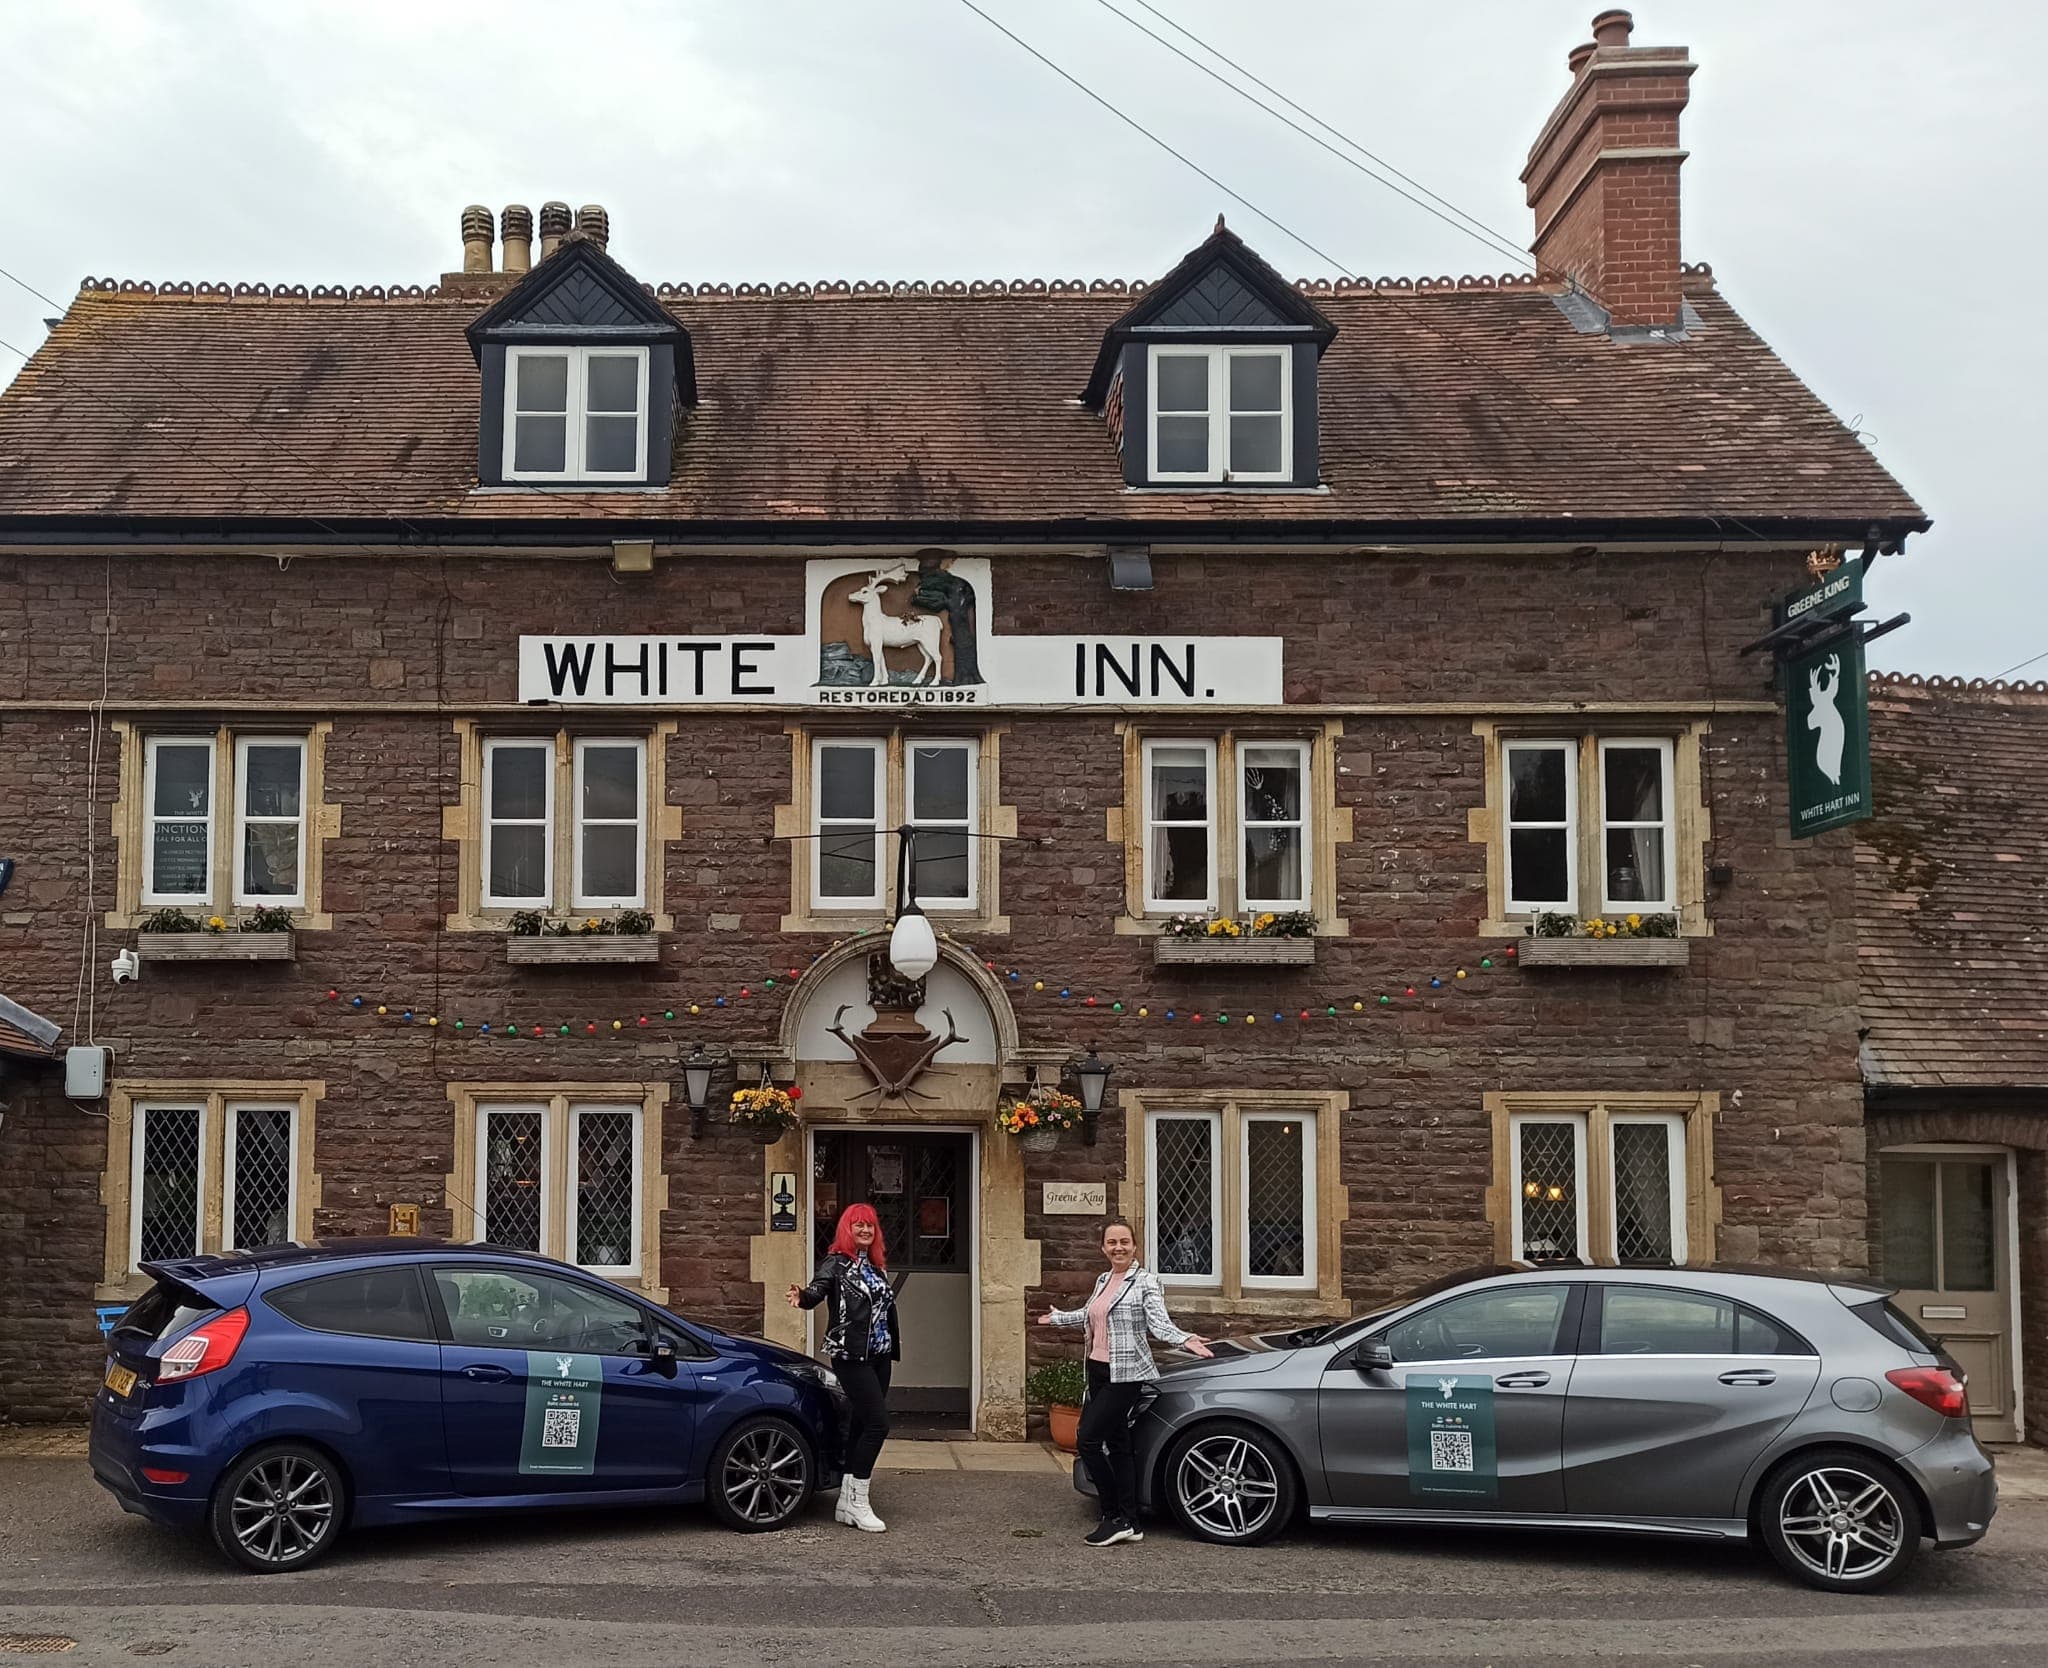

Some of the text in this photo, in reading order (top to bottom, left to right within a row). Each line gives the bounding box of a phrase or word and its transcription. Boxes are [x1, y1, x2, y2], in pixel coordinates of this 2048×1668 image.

[1788, 575, 1850, 618] GREENE KING
[543, 642, 1215, 697] WHITE INN.
[940, 691, 976, 703] 1892
[1800, 791, 1860, 821] WHITE HART INN
[1046, 1190, 1105, 1206] Greene King
[541, 1380, 552, 1388] THE
[553, 1380, 572, 1388] WHITE
[1421, 1401, 1435, 1409] THE
[1435, 1402, 1458, 1410] WHITE
